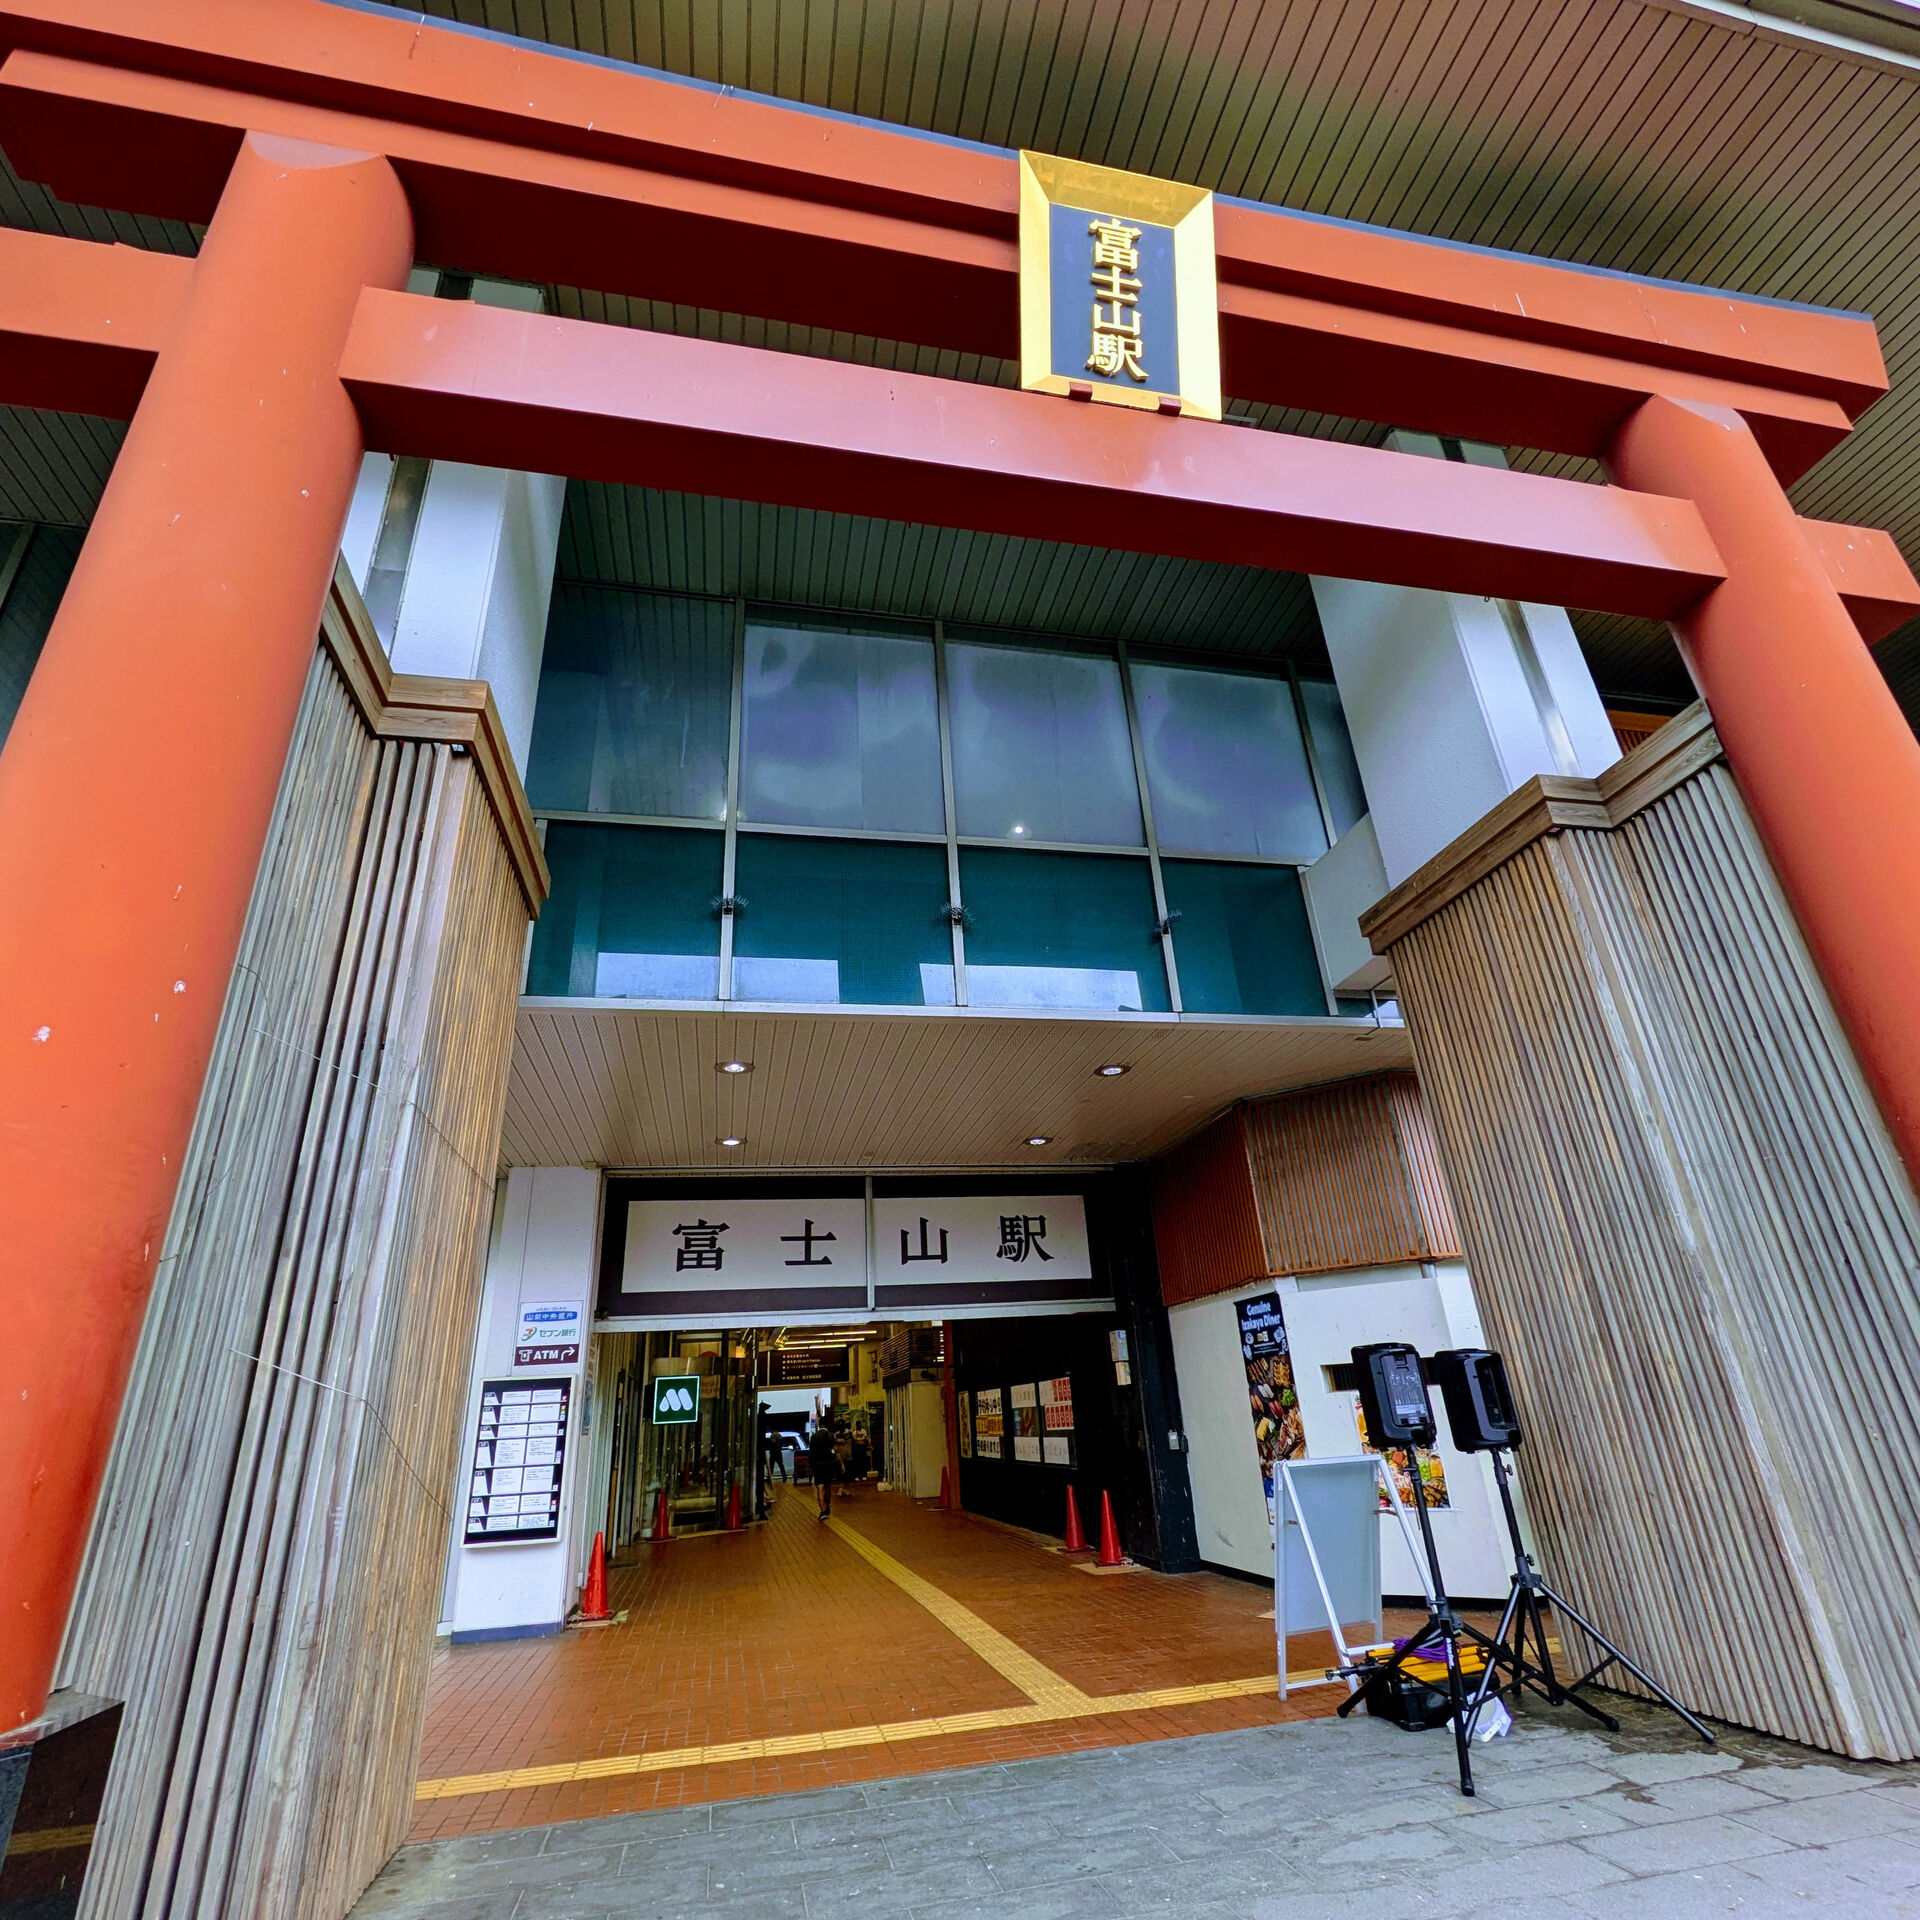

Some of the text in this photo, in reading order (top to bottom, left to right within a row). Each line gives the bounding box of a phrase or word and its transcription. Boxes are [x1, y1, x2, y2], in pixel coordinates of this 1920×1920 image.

[1086, 217, 1149, 381] 富士山駅
[672, 1214, 1054, 1272] 富士山駅
[1247, 1301, 1271, 1315] Genuine
[1241, 1314, 1280, 1330] Izakaya Diner
[533, 1349, 559, 1361] ATM
